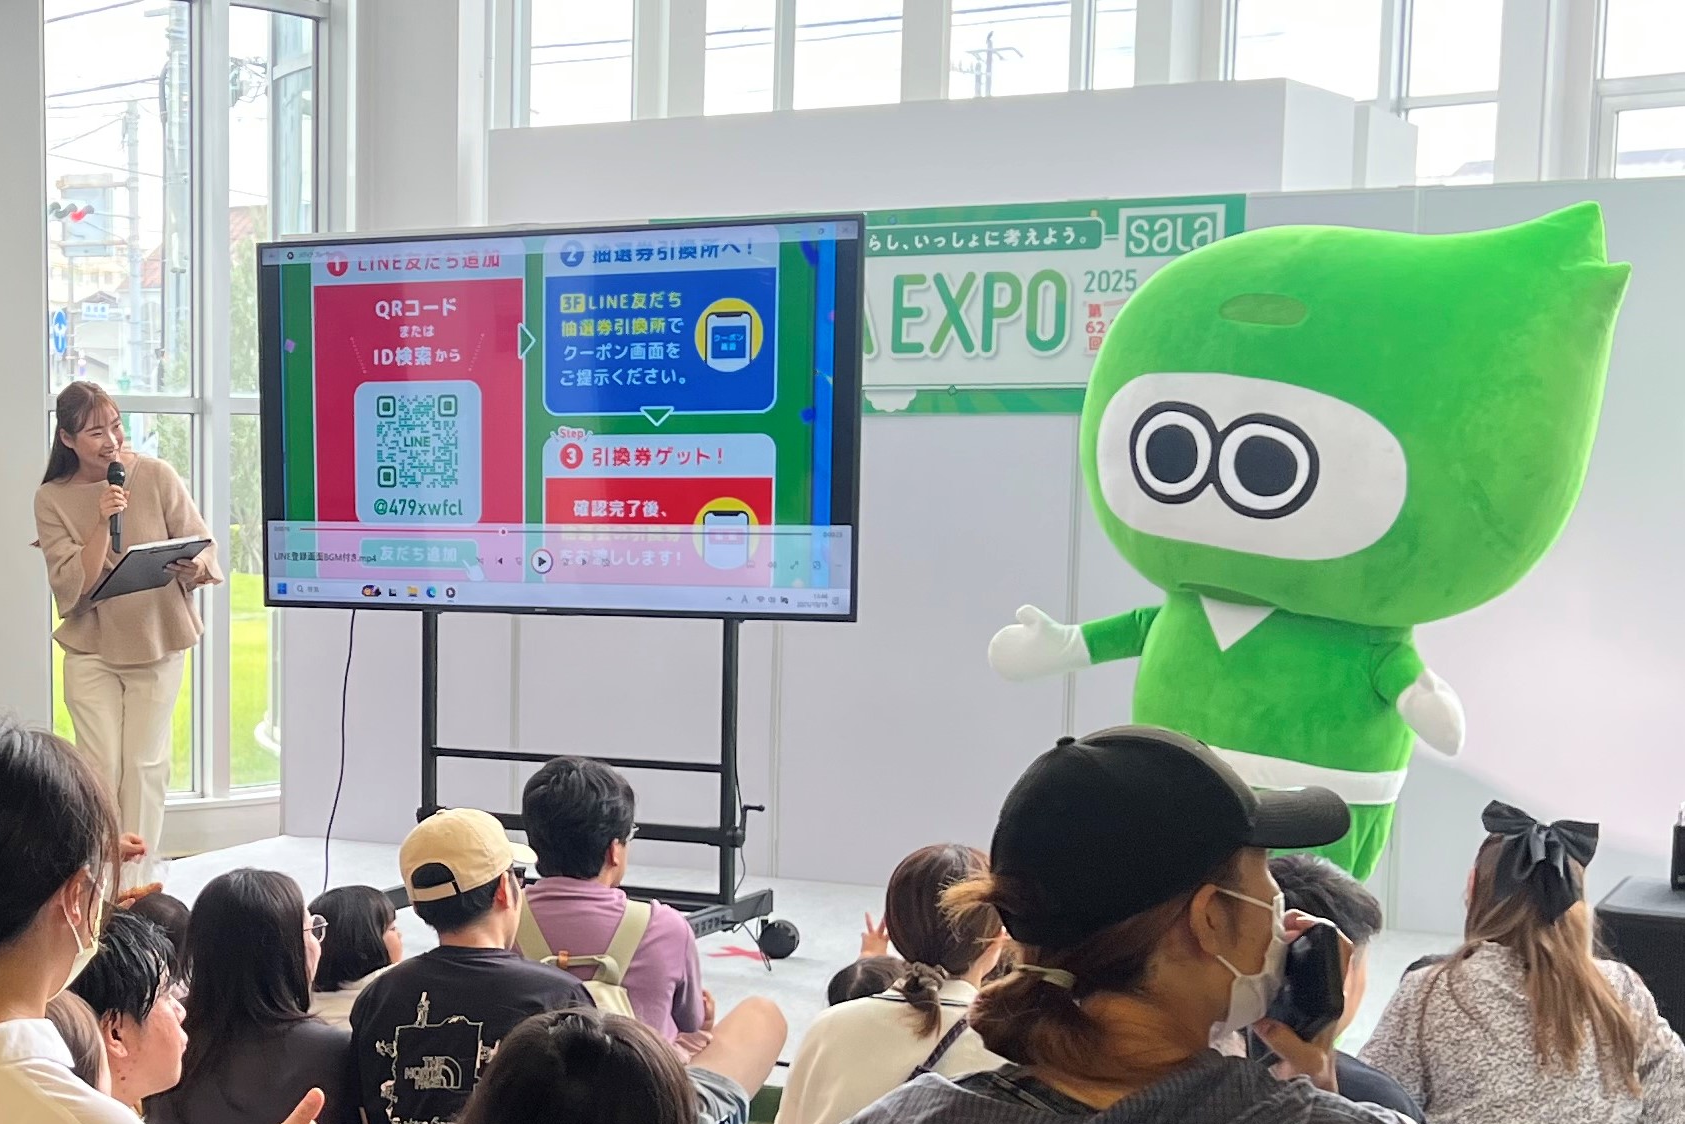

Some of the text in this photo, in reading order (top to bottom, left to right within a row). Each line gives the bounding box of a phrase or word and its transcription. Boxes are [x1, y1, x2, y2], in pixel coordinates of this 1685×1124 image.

[868, 230, 1089, 252] らし、いっしょに考えよう。
[357, 249, 500, 272] LINE友だち追加
[1083, 269, 1138, 293] 2025
[374, 297, 458, 320] QRコード
[890, 268, 1068, 354] EXPO
[398, 325, 435, 338] または
[561, 317, 685, 338] 抽選券引換所で
[372, 345, 461, 367] ID検索から
[563, 341, 682, 362] クーポン画面を
[559, 367, 687, 387] ご提示ください。
[403, 436, 431, 448] LINE
[560, 428, 585, 440] Step
[373, 498, 464, 517] @479xwfcl
[573, 499, 668, 519] 確認完了後、
[379, 545, 458, 563] 友だち追加
